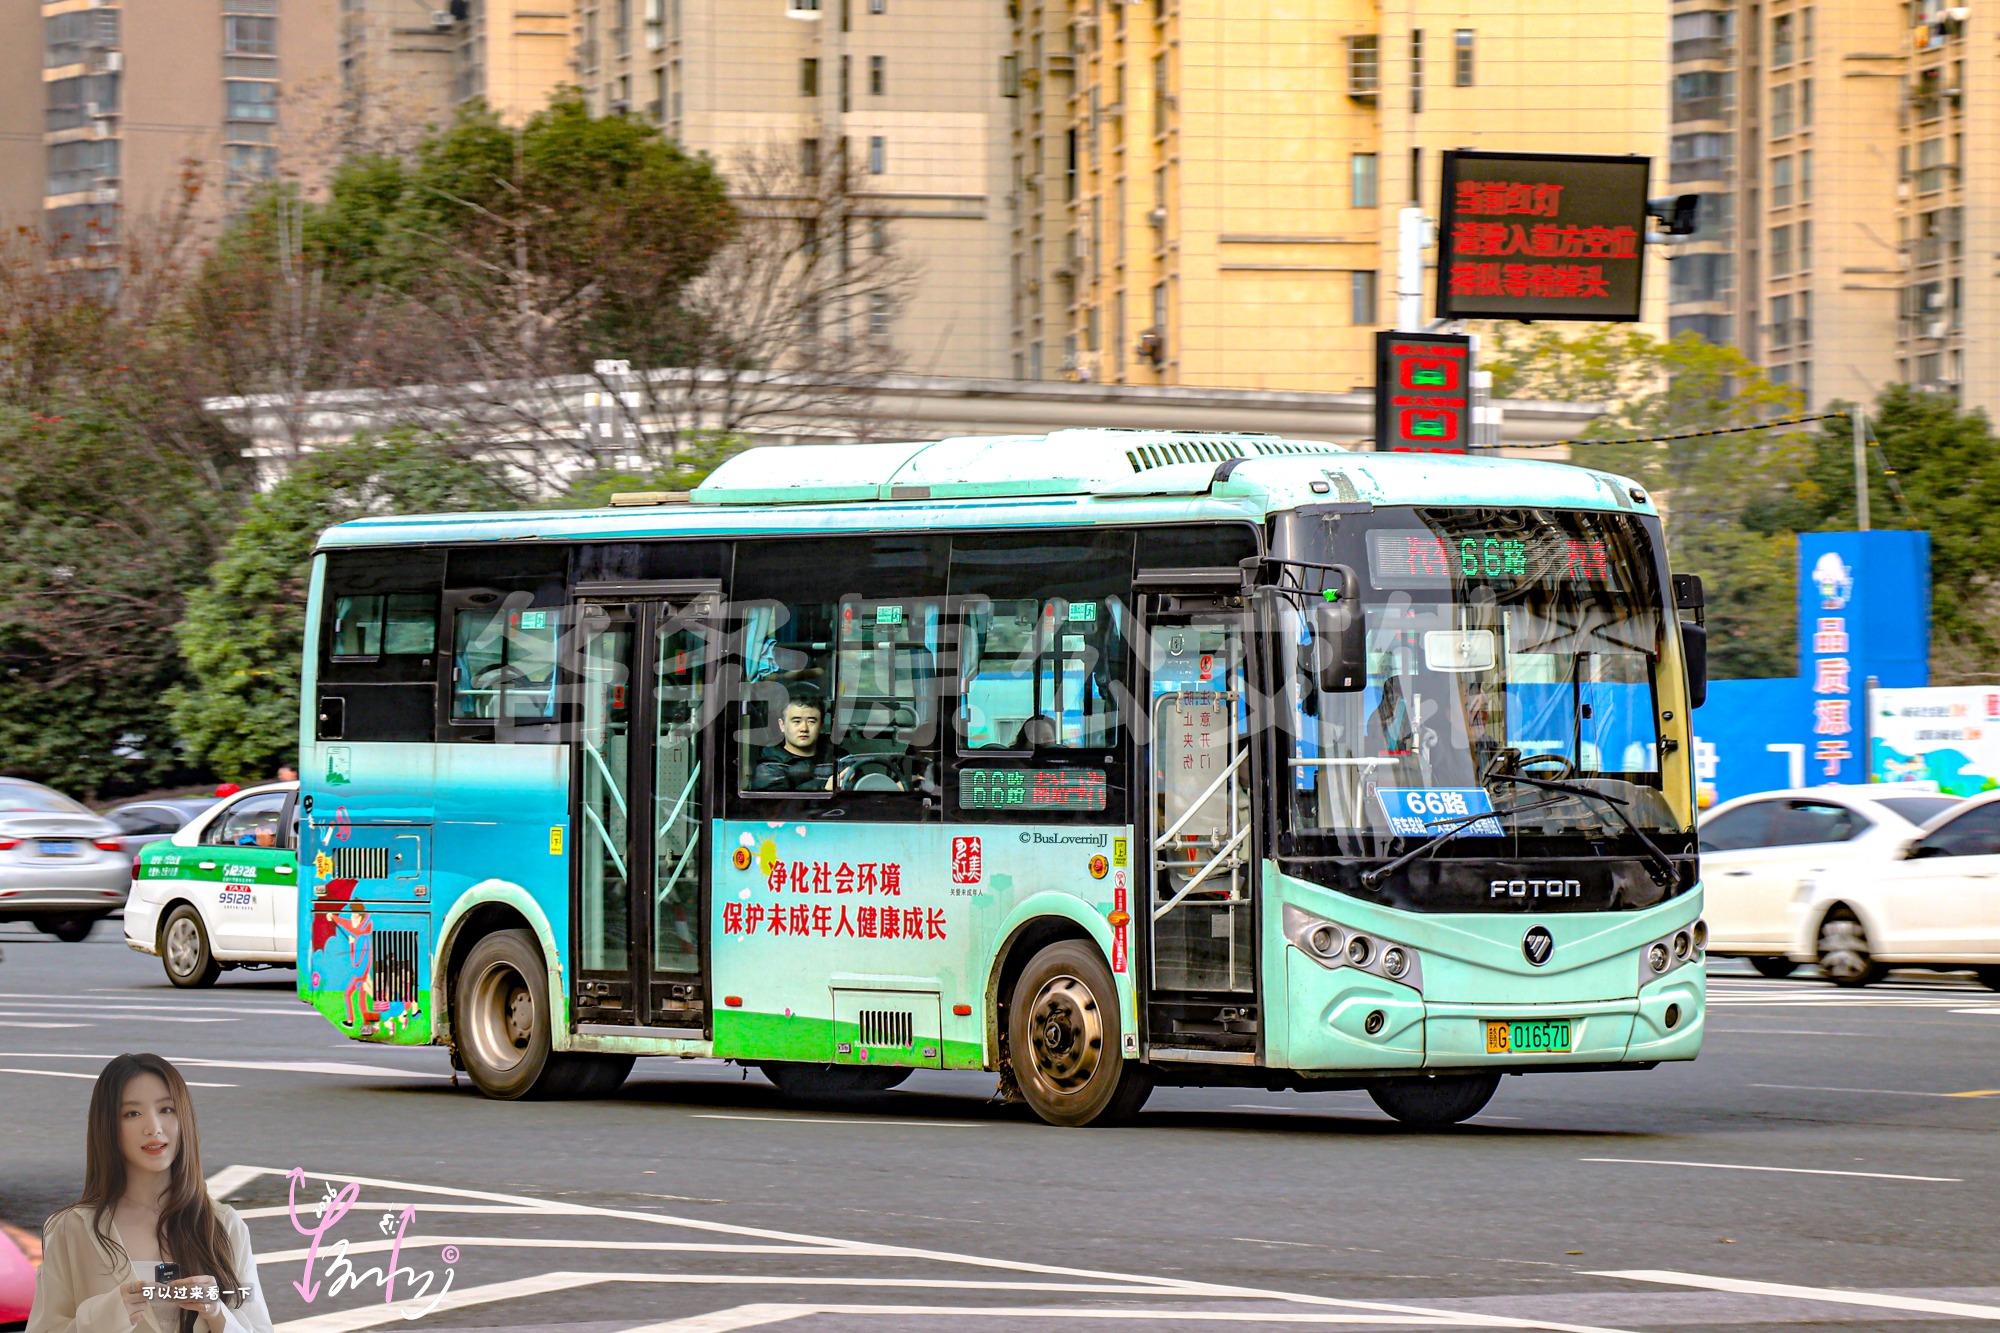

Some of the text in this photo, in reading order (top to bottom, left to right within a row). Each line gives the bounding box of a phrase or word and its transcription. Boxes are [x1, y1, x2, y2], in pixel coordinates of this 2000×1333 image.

[1460, 537, 1528, 577] 66路
[1813, 617, 1852, 788] 品质源于
[1406, 791, 1469, 815] 66路
[767, 861, 901, 896] 净化社会环境
[1490, 880, 1581, 898] FOTON
[219, 893, 250, 904] 95128
[722, 902, 948, 941] 保护未成年人健康成长
